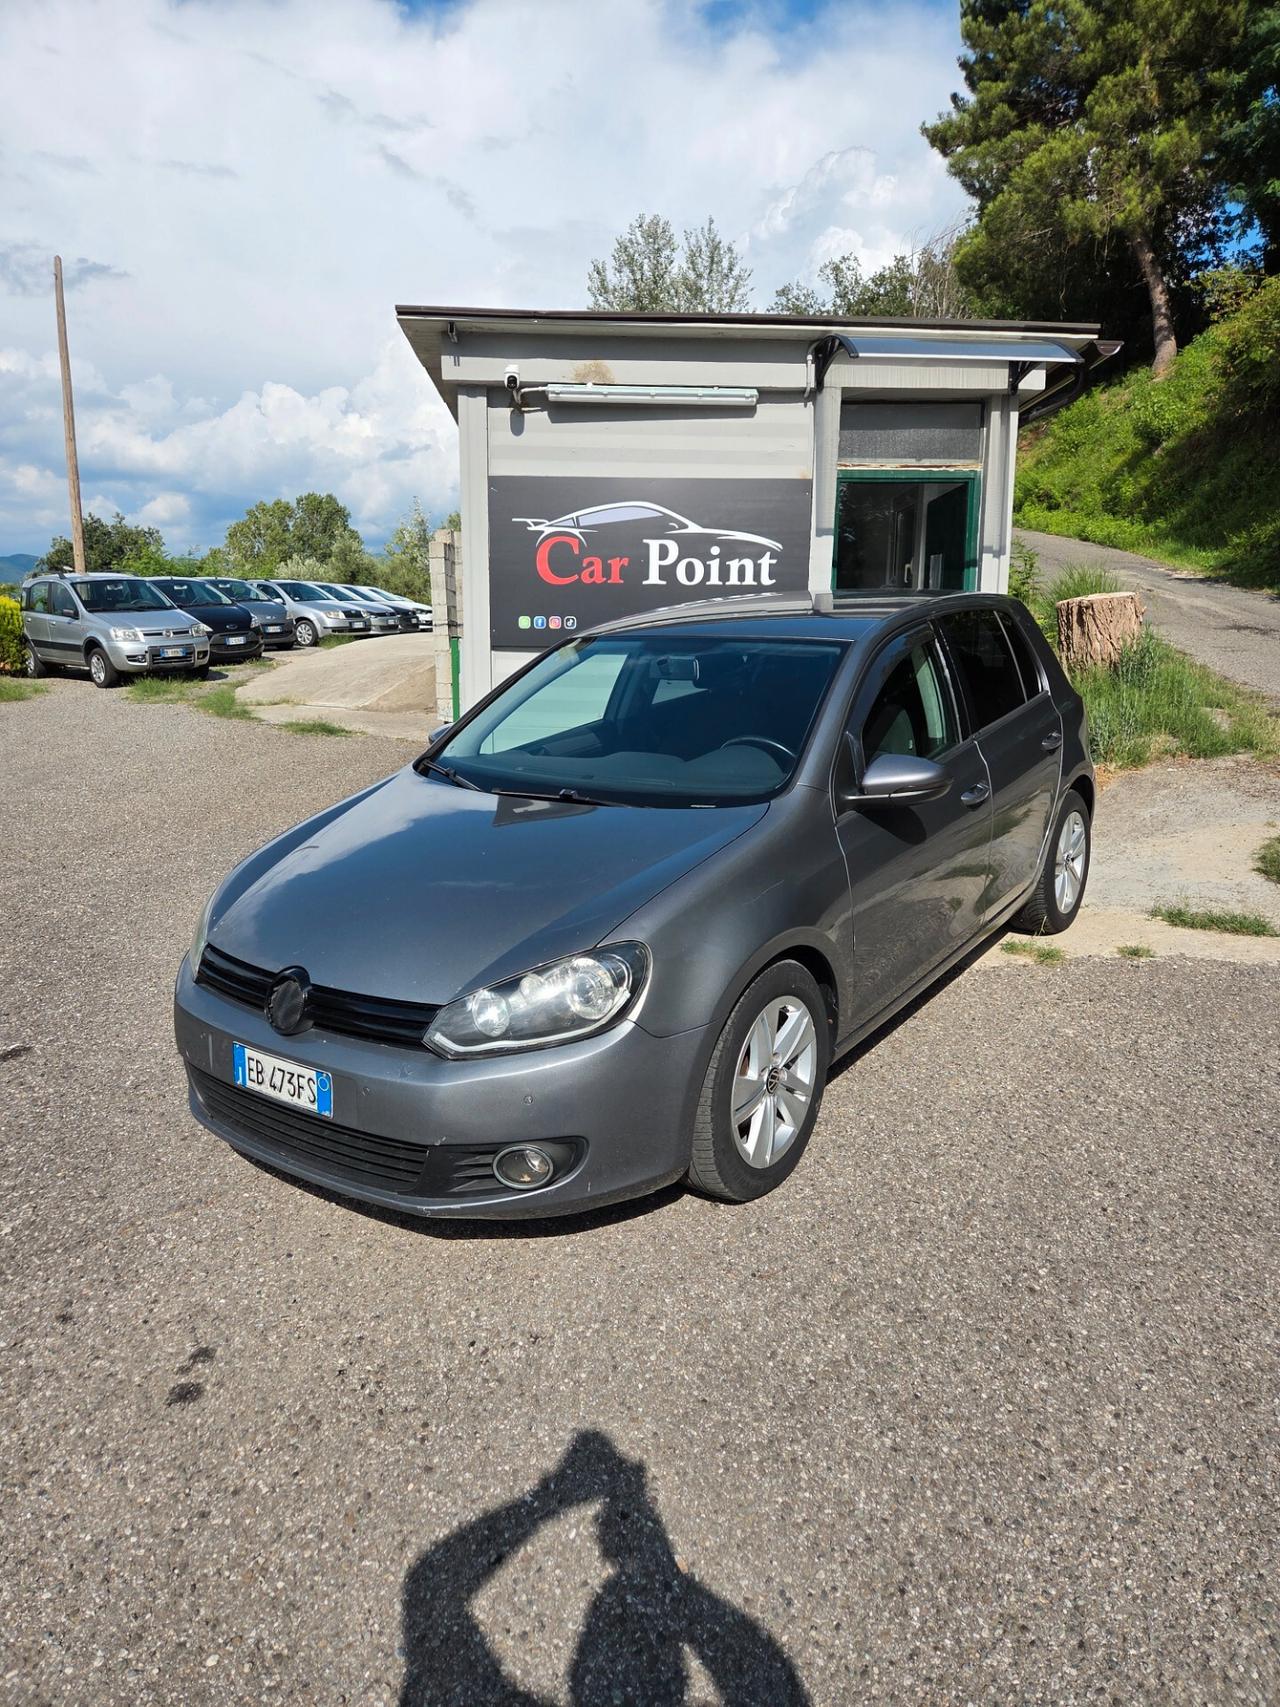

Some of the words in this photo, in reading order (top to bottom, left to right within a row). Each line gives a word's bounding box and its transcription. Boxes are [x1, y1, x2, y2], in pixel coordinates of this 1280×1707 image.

[535, 535, 629, 586] Car
[642, 538, 777, 586] Point
[247, 1056, 265, 1085] EB
